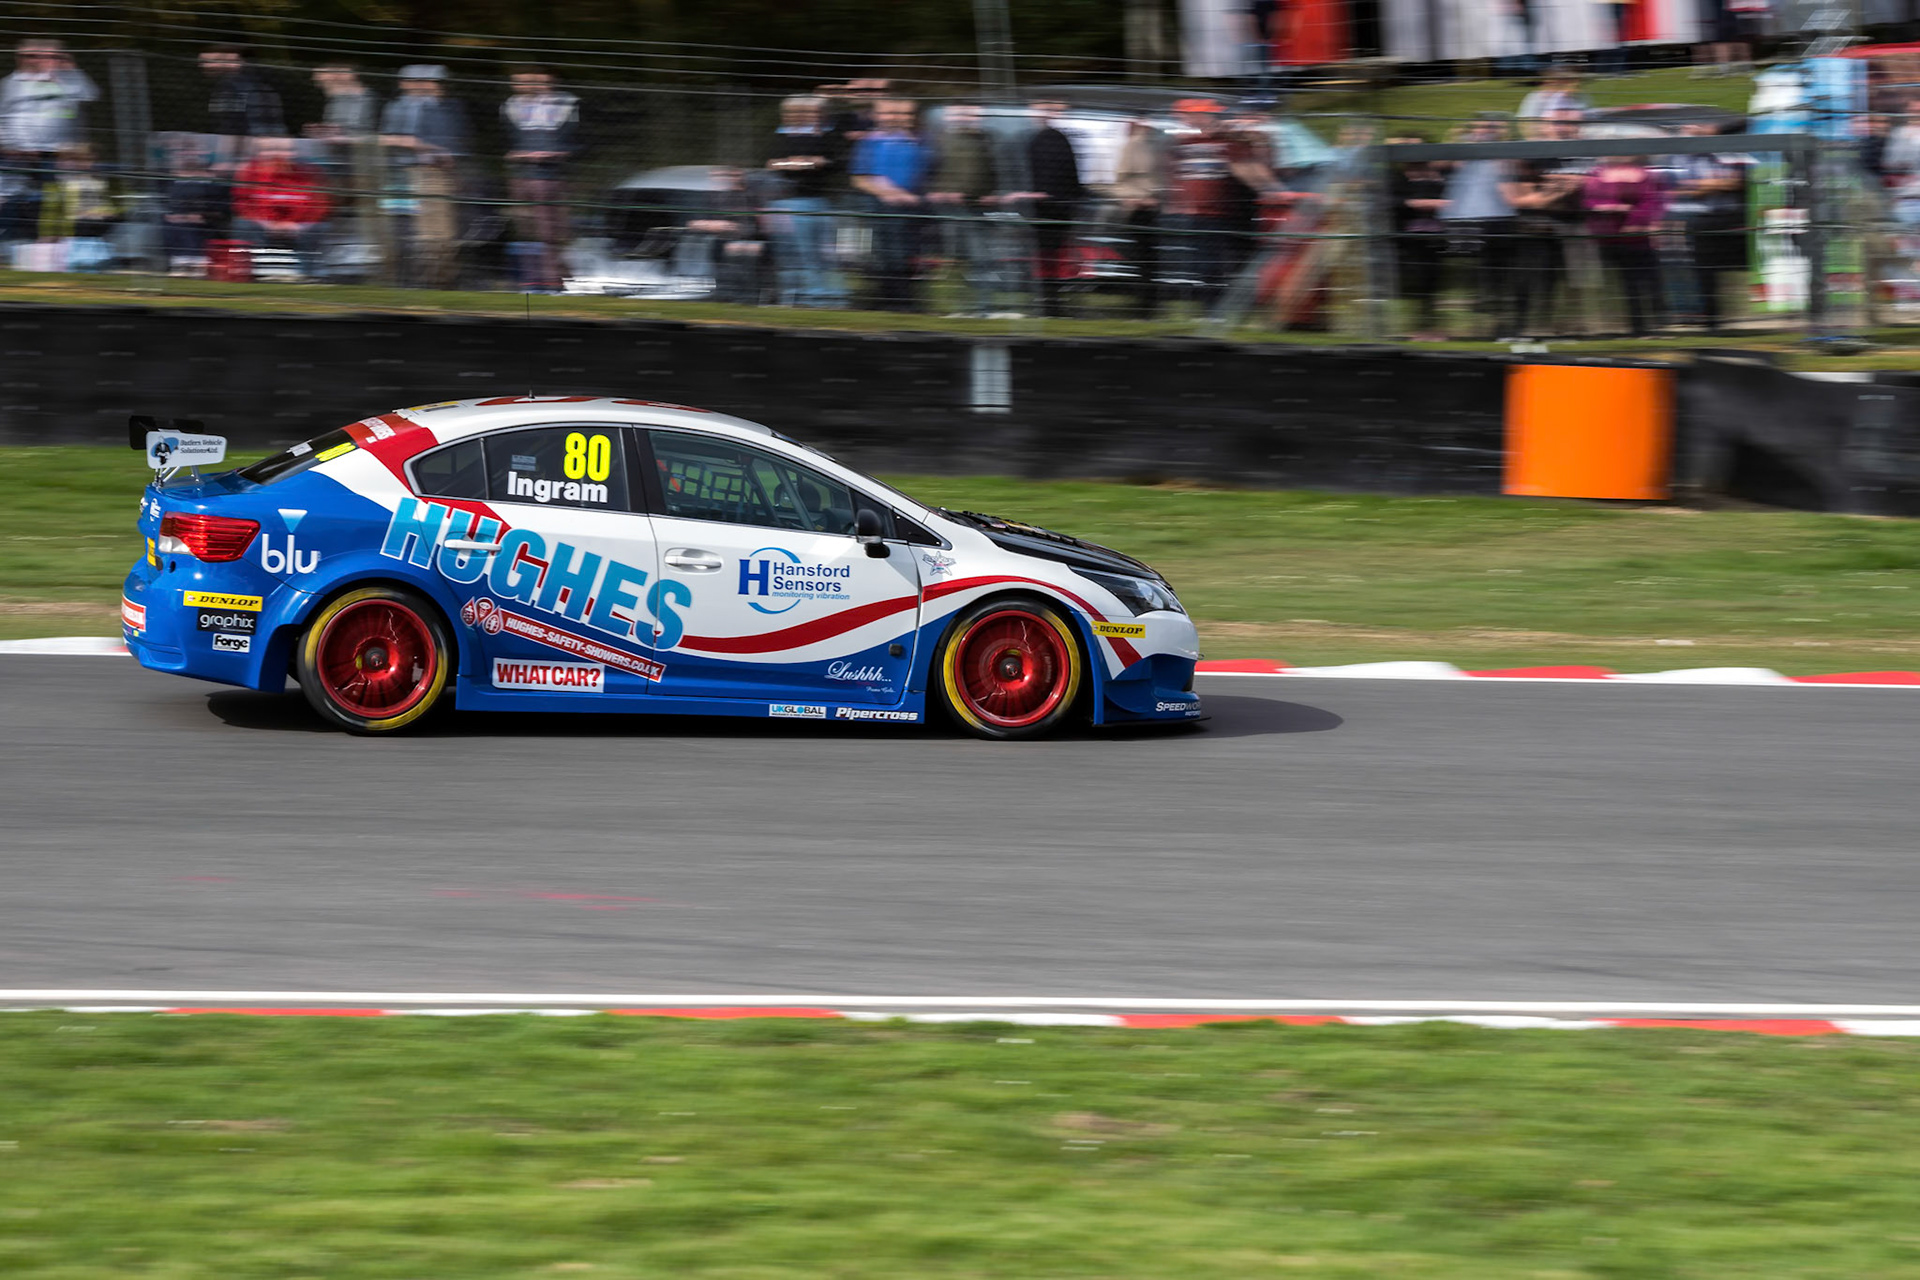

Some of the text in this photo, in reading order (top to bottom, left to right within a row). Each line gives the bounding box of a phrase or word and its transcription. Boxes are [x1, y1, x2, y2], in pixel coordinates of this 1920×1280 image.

[563, 432, 611, 482] 80
[507, 471, 608, 503] Ingram
[261, 533, 318, 574] blu
[380, 496, 692, 651] HUGHES
[738, 559, 770, 596] H
[773, 561, 850, 578] Hansford
[773, 576, 842, 592] Sensors
[199, 595, 258, 606] DUNLOP
[772, 591, 850, 600] monitoring vibration
[200, 613, 254, 628] graphix
[1099, 625, 1142, 635] DUNLOP
[215, 635, 248, 650] Forge
[835, 707, 918, 721] Pipercross
